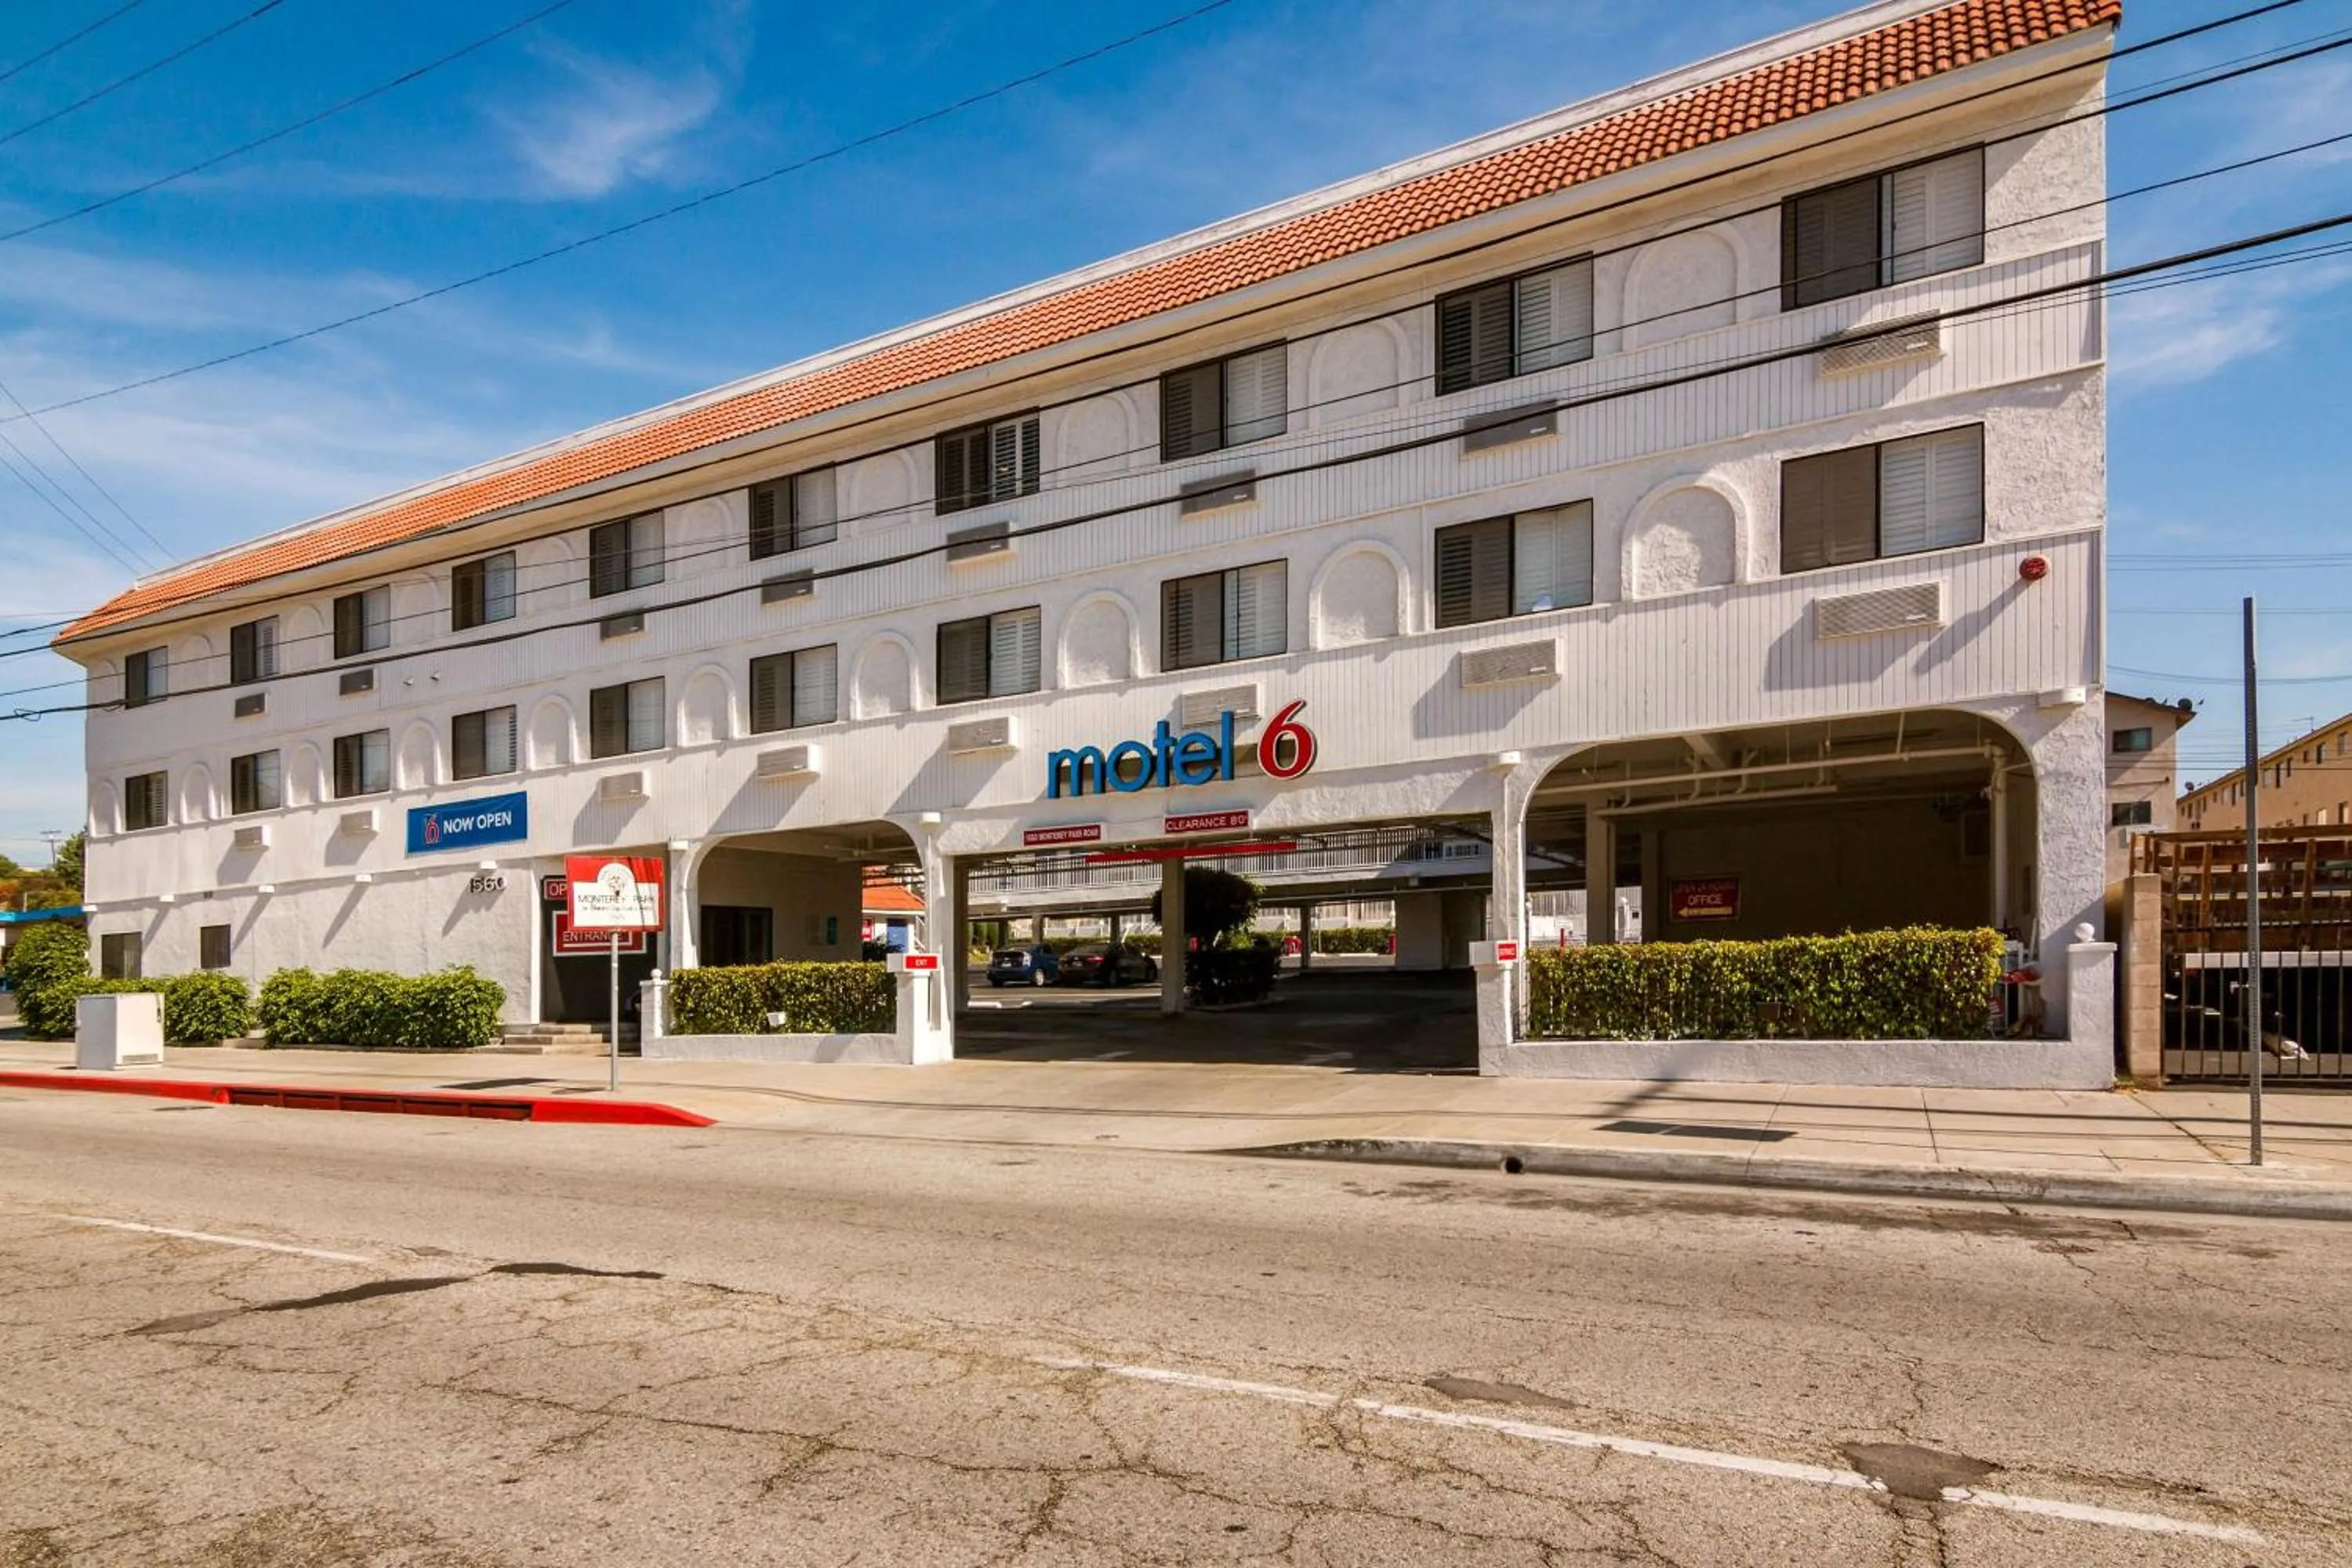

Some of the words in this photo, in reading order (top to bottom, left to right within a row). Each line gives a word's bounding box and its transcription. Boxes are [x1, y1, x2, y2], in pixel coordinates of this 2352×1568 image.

[1047, 710, 1235, 799] motel
[1257, 697, 1318, 780] 6
[443, 816, 474, 835] NOW
[476, 810, 512, 829] OPEN
[1166, 816, 1227, 831] CLEARANCE
[471, 876, 508, 893] 560
[549, 882, 568, 896] OP
[578, 895, 626, 904] MONTEREY
[1687, 893, 1723, 906] OFFICE
